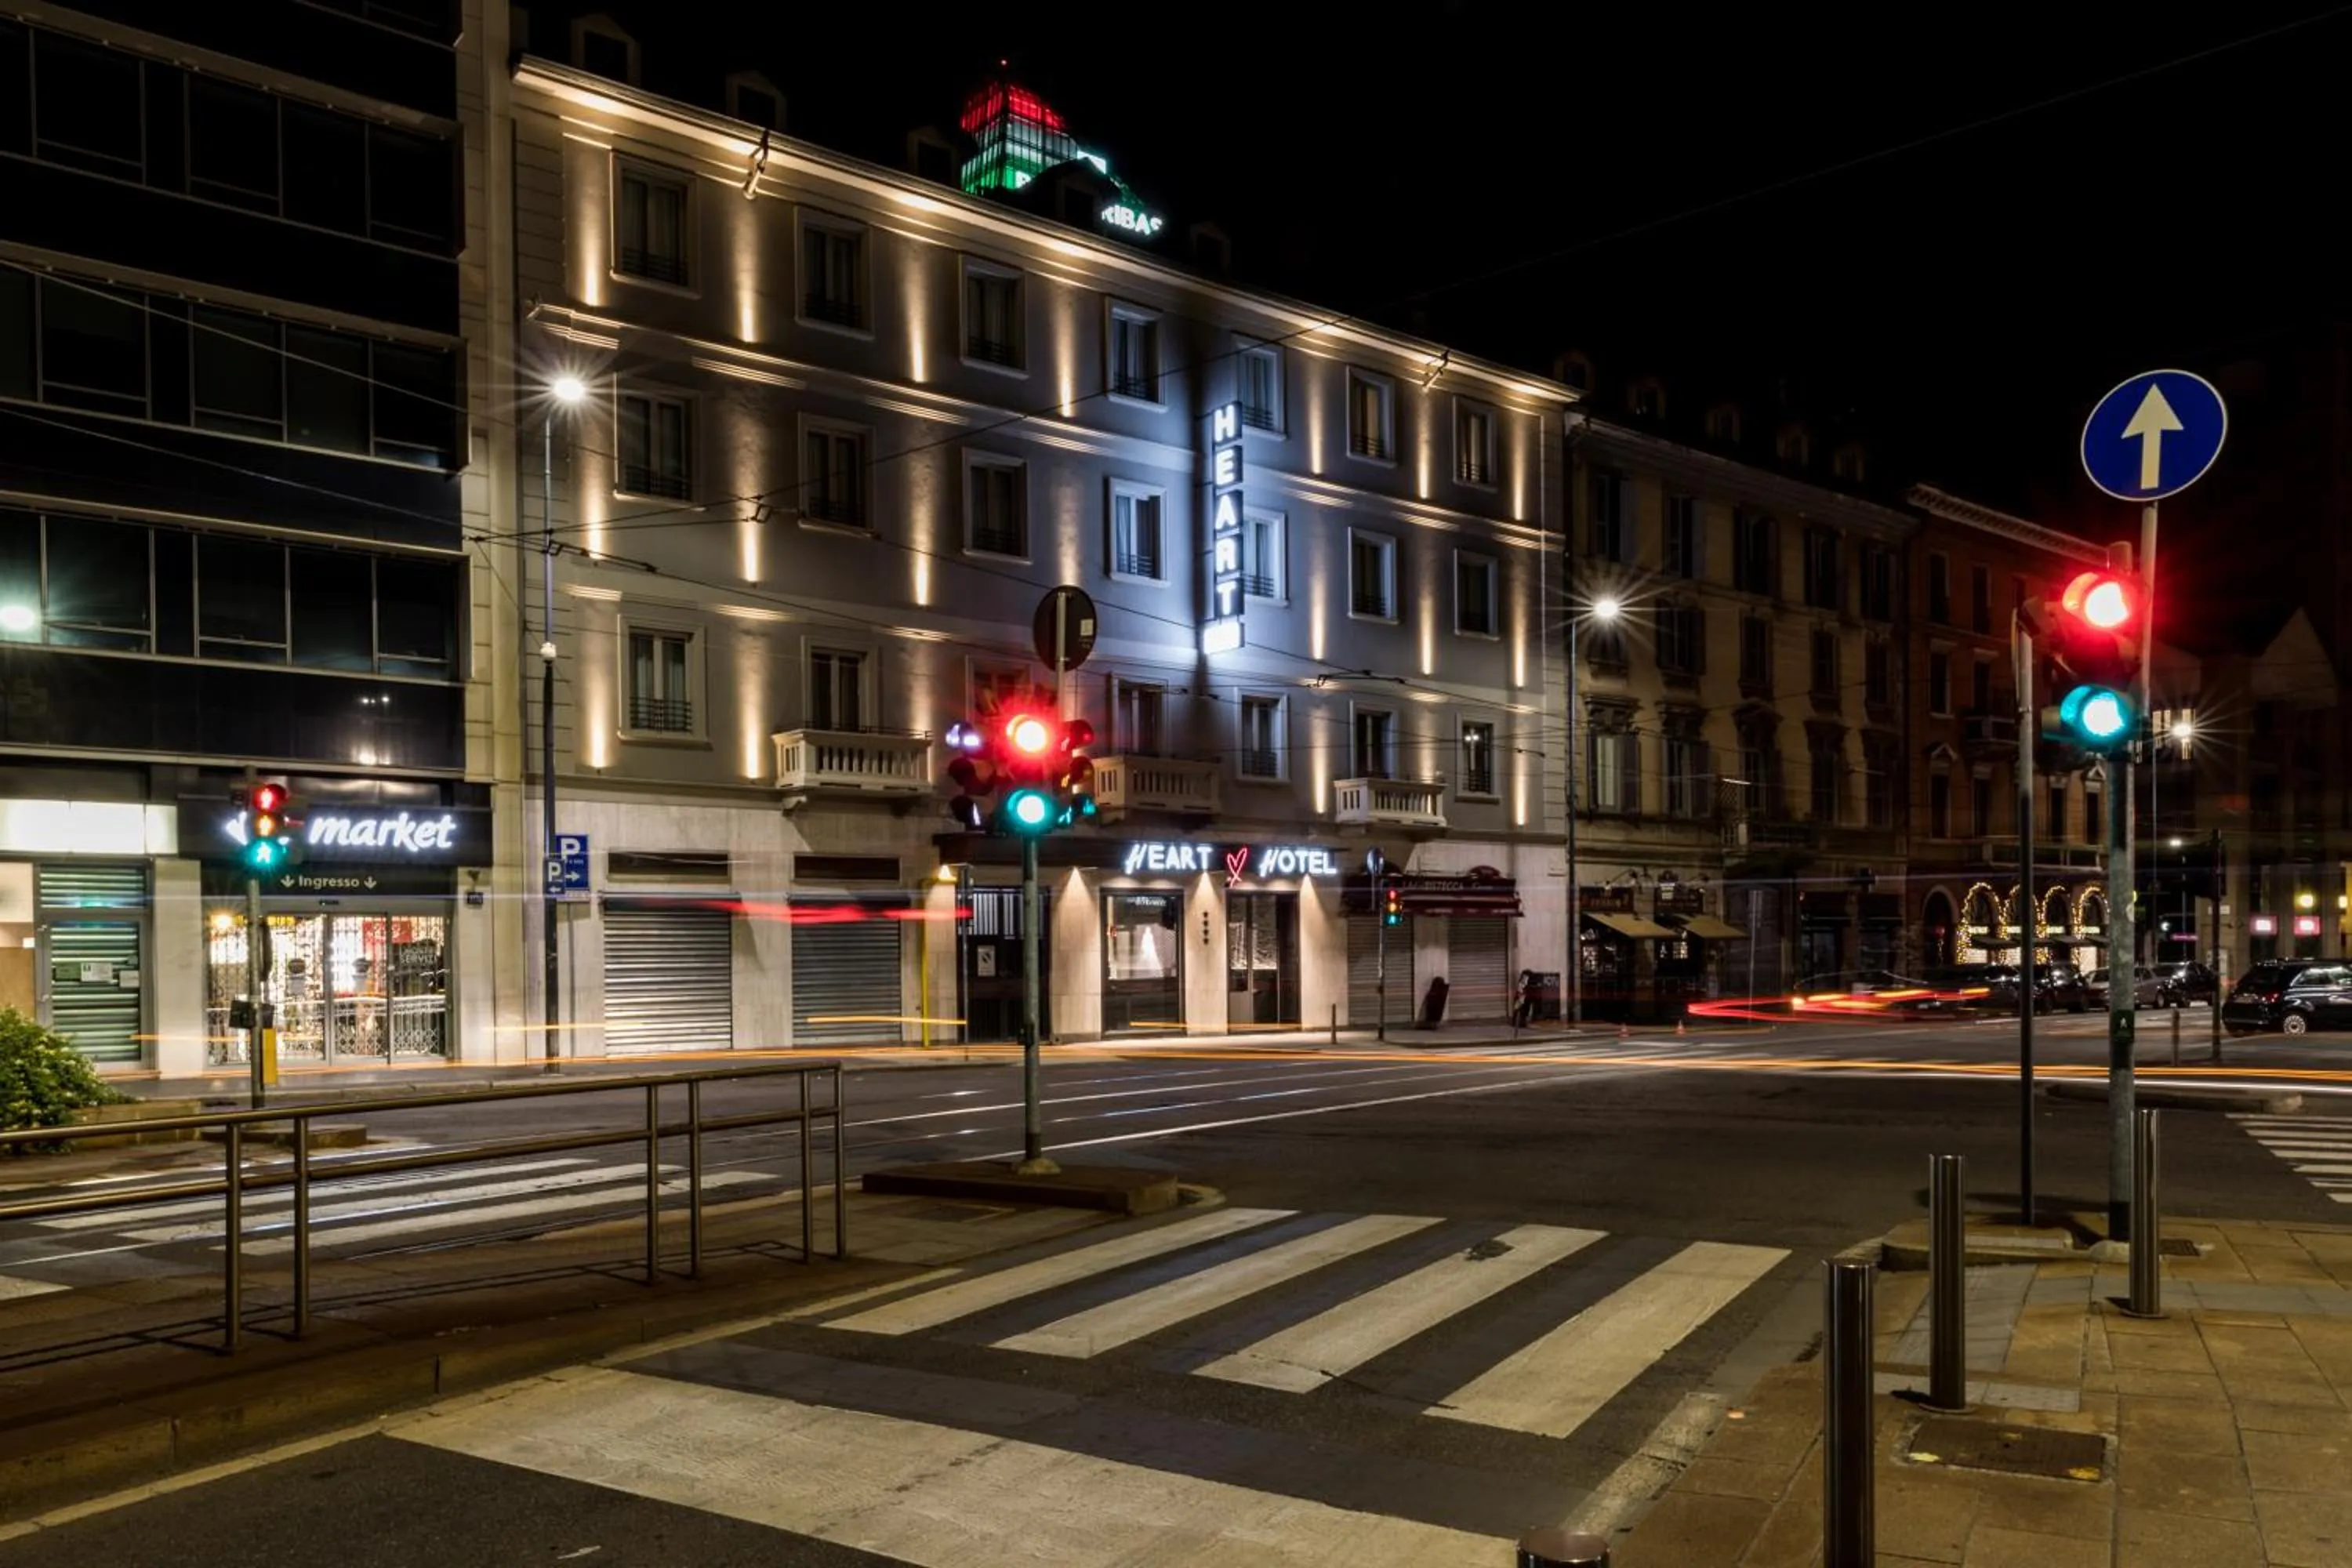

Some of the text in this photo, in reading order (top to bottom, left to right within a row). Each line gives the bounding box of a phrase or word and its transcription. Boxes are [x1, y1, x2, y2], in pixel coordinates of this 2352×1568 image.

[1214, 405, 1237, 615] HEART
[309, 812, 456, 851] market
[561, 837, 581, 861] P
[1124, 843, 1338, 877] HEART HOTEL
[299, 876, 360, 889] Ingresso
[548, 862, 562, 882] P
